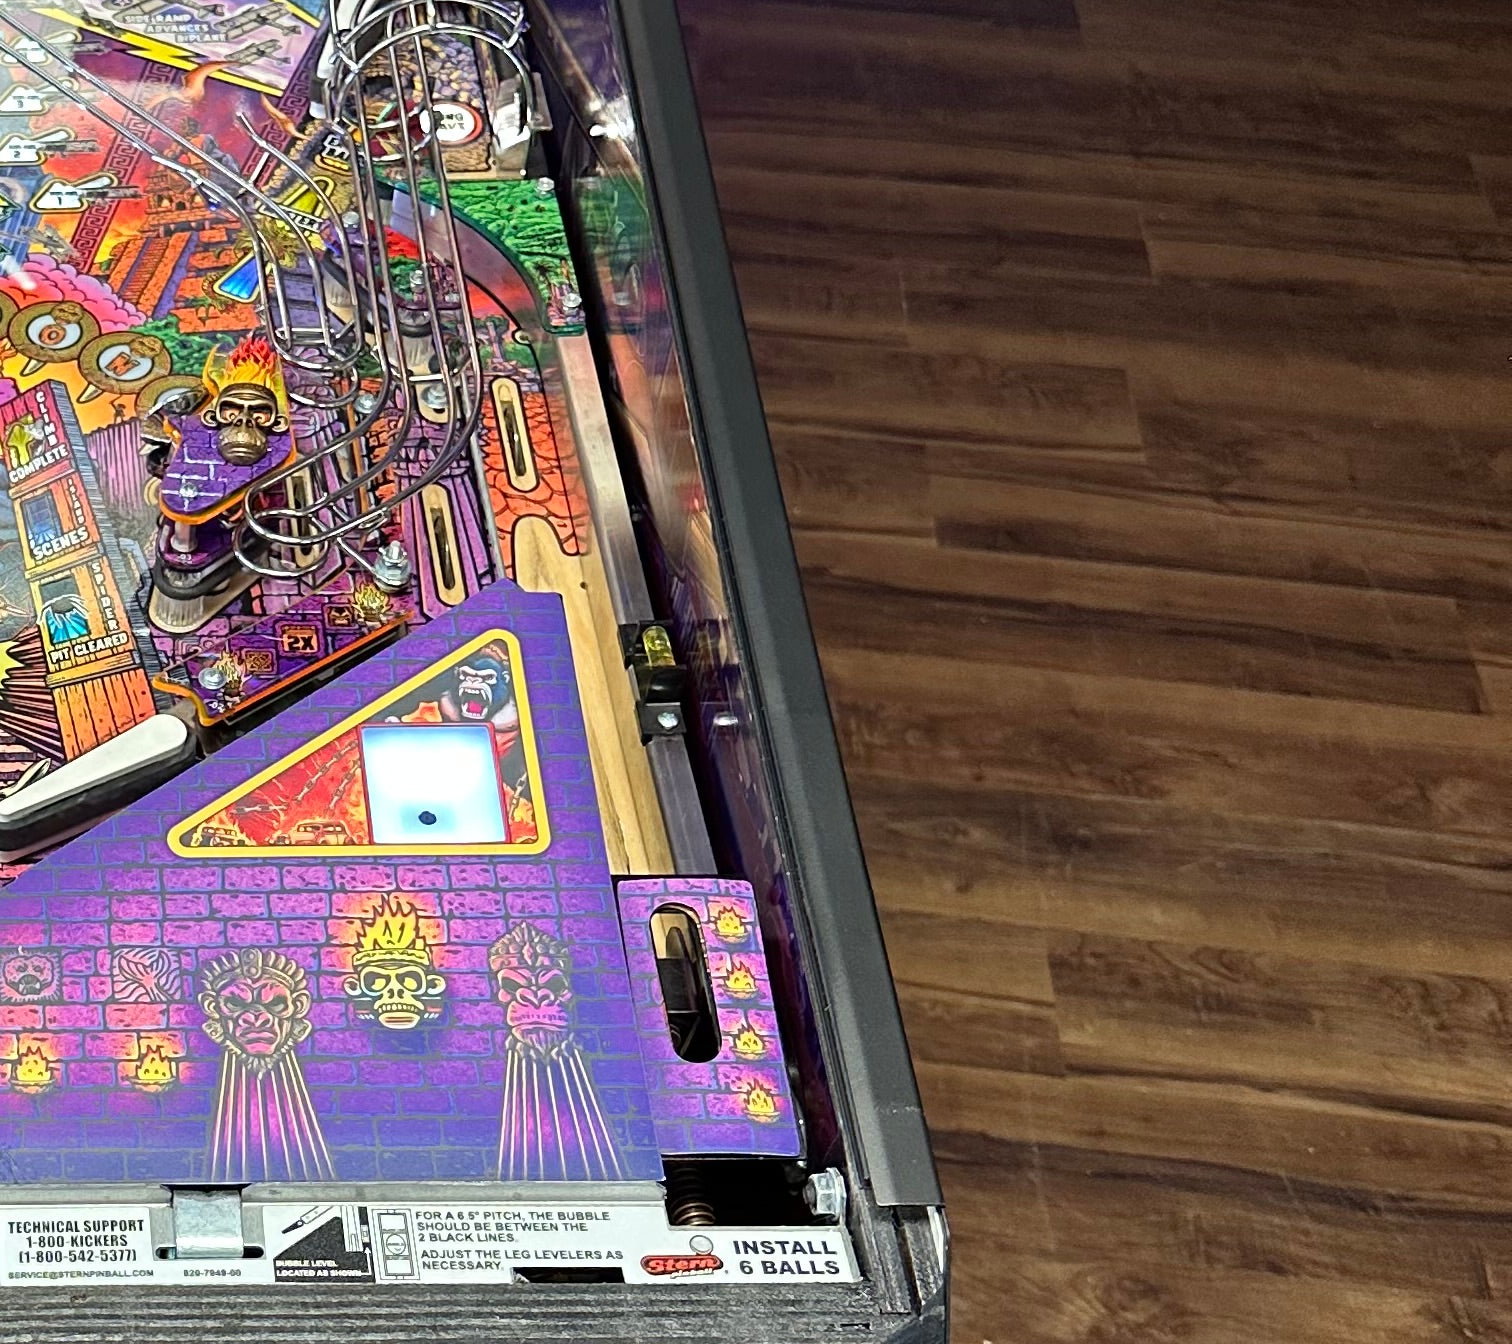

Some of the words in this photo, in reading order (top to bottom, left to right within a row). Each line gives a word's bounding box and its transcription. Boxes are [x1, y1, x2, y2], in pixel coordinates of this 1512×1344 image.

[35, 391, 58, 447] CLIMB
[8, 444, 69, 484] COMPLETE
[32, 527, 89, 561] SCENES
[91, 561, 119, 632] SPIDER
[49, 649, 71, 664] PIT
[74, 633, 128, 656] CLEARED
[288, 634, 315, 651] 2X
[415, 1211, 442, 1220] FOR
[445, 1212, 455, 1220] A
[483, 1211, 526, 1222] PITCH,
[528, 1212, 554, 1220] THE
[557, 1211, 611, 1221] BUBBLE
[8, 1220, 80, 1234] TECHNICAL
[83, 1219, 144, 1232] SUPPORT
[417, 1222, 471, 1231] SHOULD
[474, 1222, 492, 1231] BE
[495, 1222, 559, 1231] BETWEEN
[563, 1222, 589, 1231] THE
[25, 1235, 128, 1248] 1-800-KICKERS
[418, 1233, 426, 1242] 2
[429, 1233, 474, 1242] BLACK
[732, 1240, 838, 1255] INSTALL
[19, 1249, 137, 1263] (1-800-542-5377)
[421, 1250, 472, 1259] ADJUST
[475, 1250, 501, 1259] THE
[505, 1250, 530, 1259] LEG
[534, 1250, 602, 1260] LEVELERS
[605, 1250, 624, 1260] AS
[275, 1259, 310, 1267] BUBBLE
[422, 1260, 505, 1271] NECESSARY.
[646, 1258, 719, 1272] Stern
[739, 1260, 754, 1275] 6
[761, 1260, 840, 1275] BALLS
[8, 1268, 154, 1280] SERVICE@STERNPINBALL.COM
[276, 1269, 316, 1277] LOCATED
